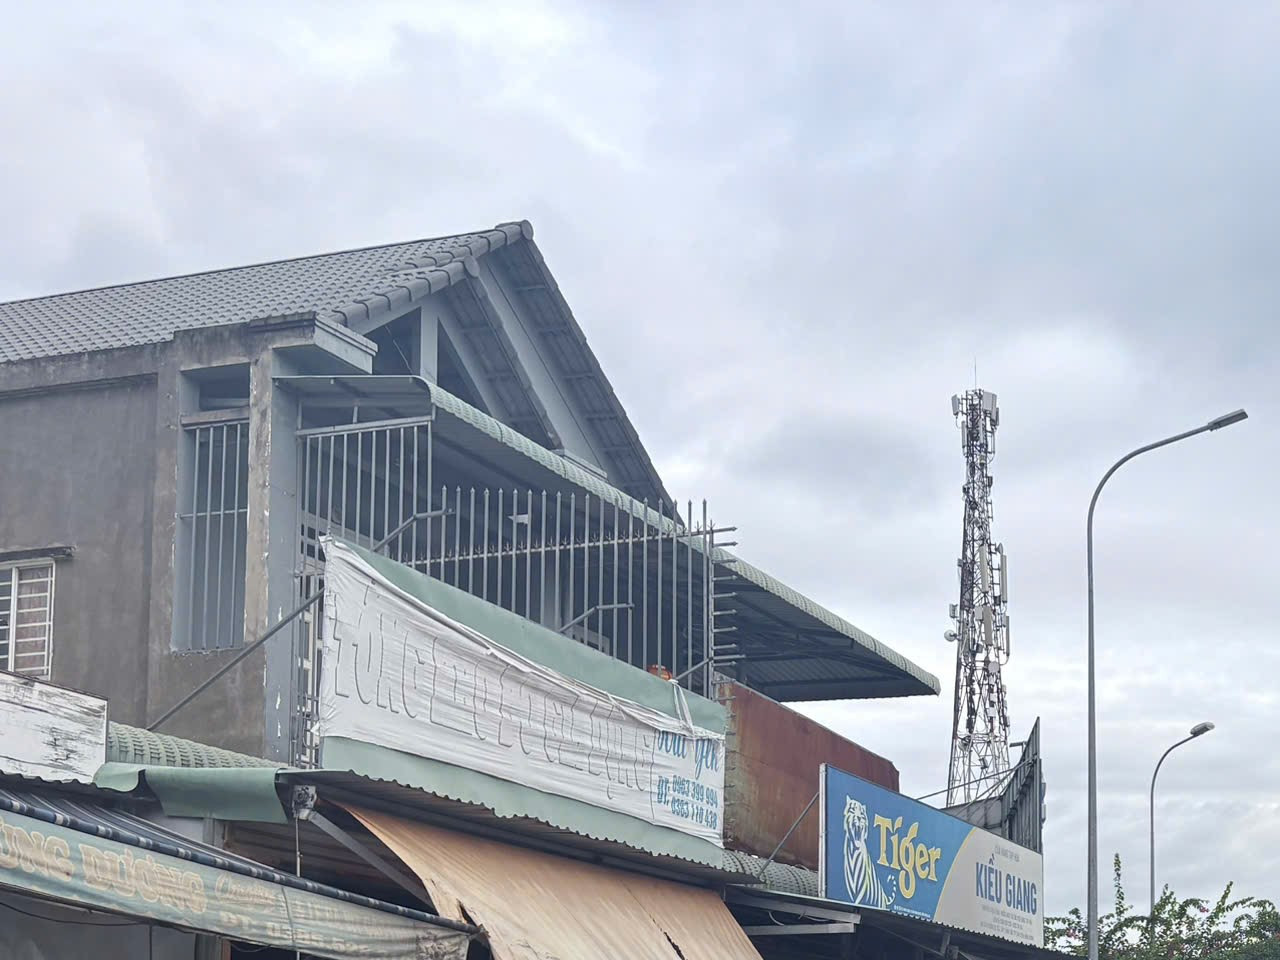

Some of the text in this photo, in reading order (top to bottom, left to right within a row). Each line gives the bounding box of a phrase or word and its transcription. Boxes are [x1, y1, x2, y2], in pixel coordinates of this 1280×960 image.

[874, 814, 941, 899] Tiger
[976, 853, 1002, 904] KIỀU
[1005, 873, 1037, 916] GIANG
